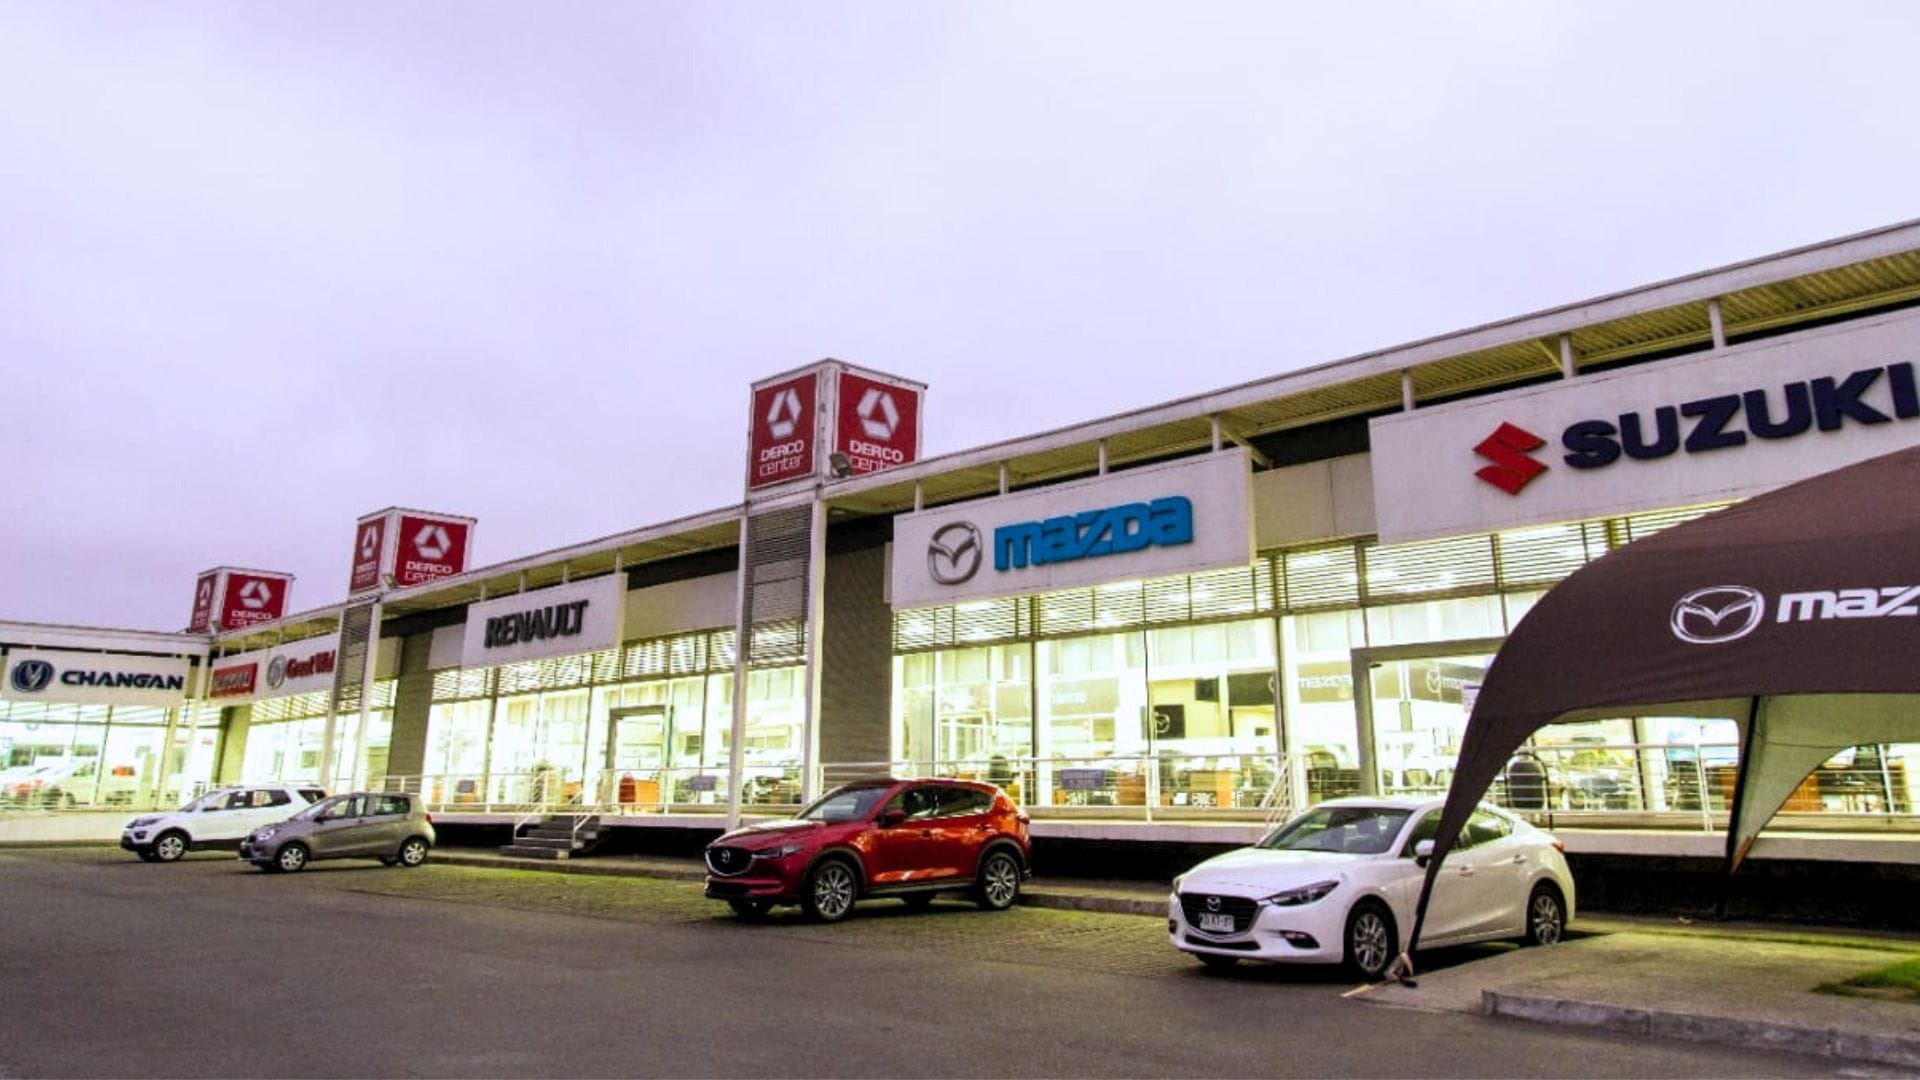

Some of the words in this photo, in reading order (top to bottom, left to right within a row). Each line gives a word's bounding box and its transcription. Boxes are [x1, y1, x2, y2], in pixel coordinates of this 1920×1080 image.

[1562, 361, 1920, 470] SUZUKI
[761, 440, 804, 462] DERCO
[849, 440, 904, 463] DERCO
[760, 455, 803, 476] center
[994, 495, 1193, 572] mazda
[406, 560, 453, 574] DERCO
[1776, 584, 1920, 623] maz
[484, 599, 589, 649] RENAULT
[60, 669, 184, 691] CHANGAN
